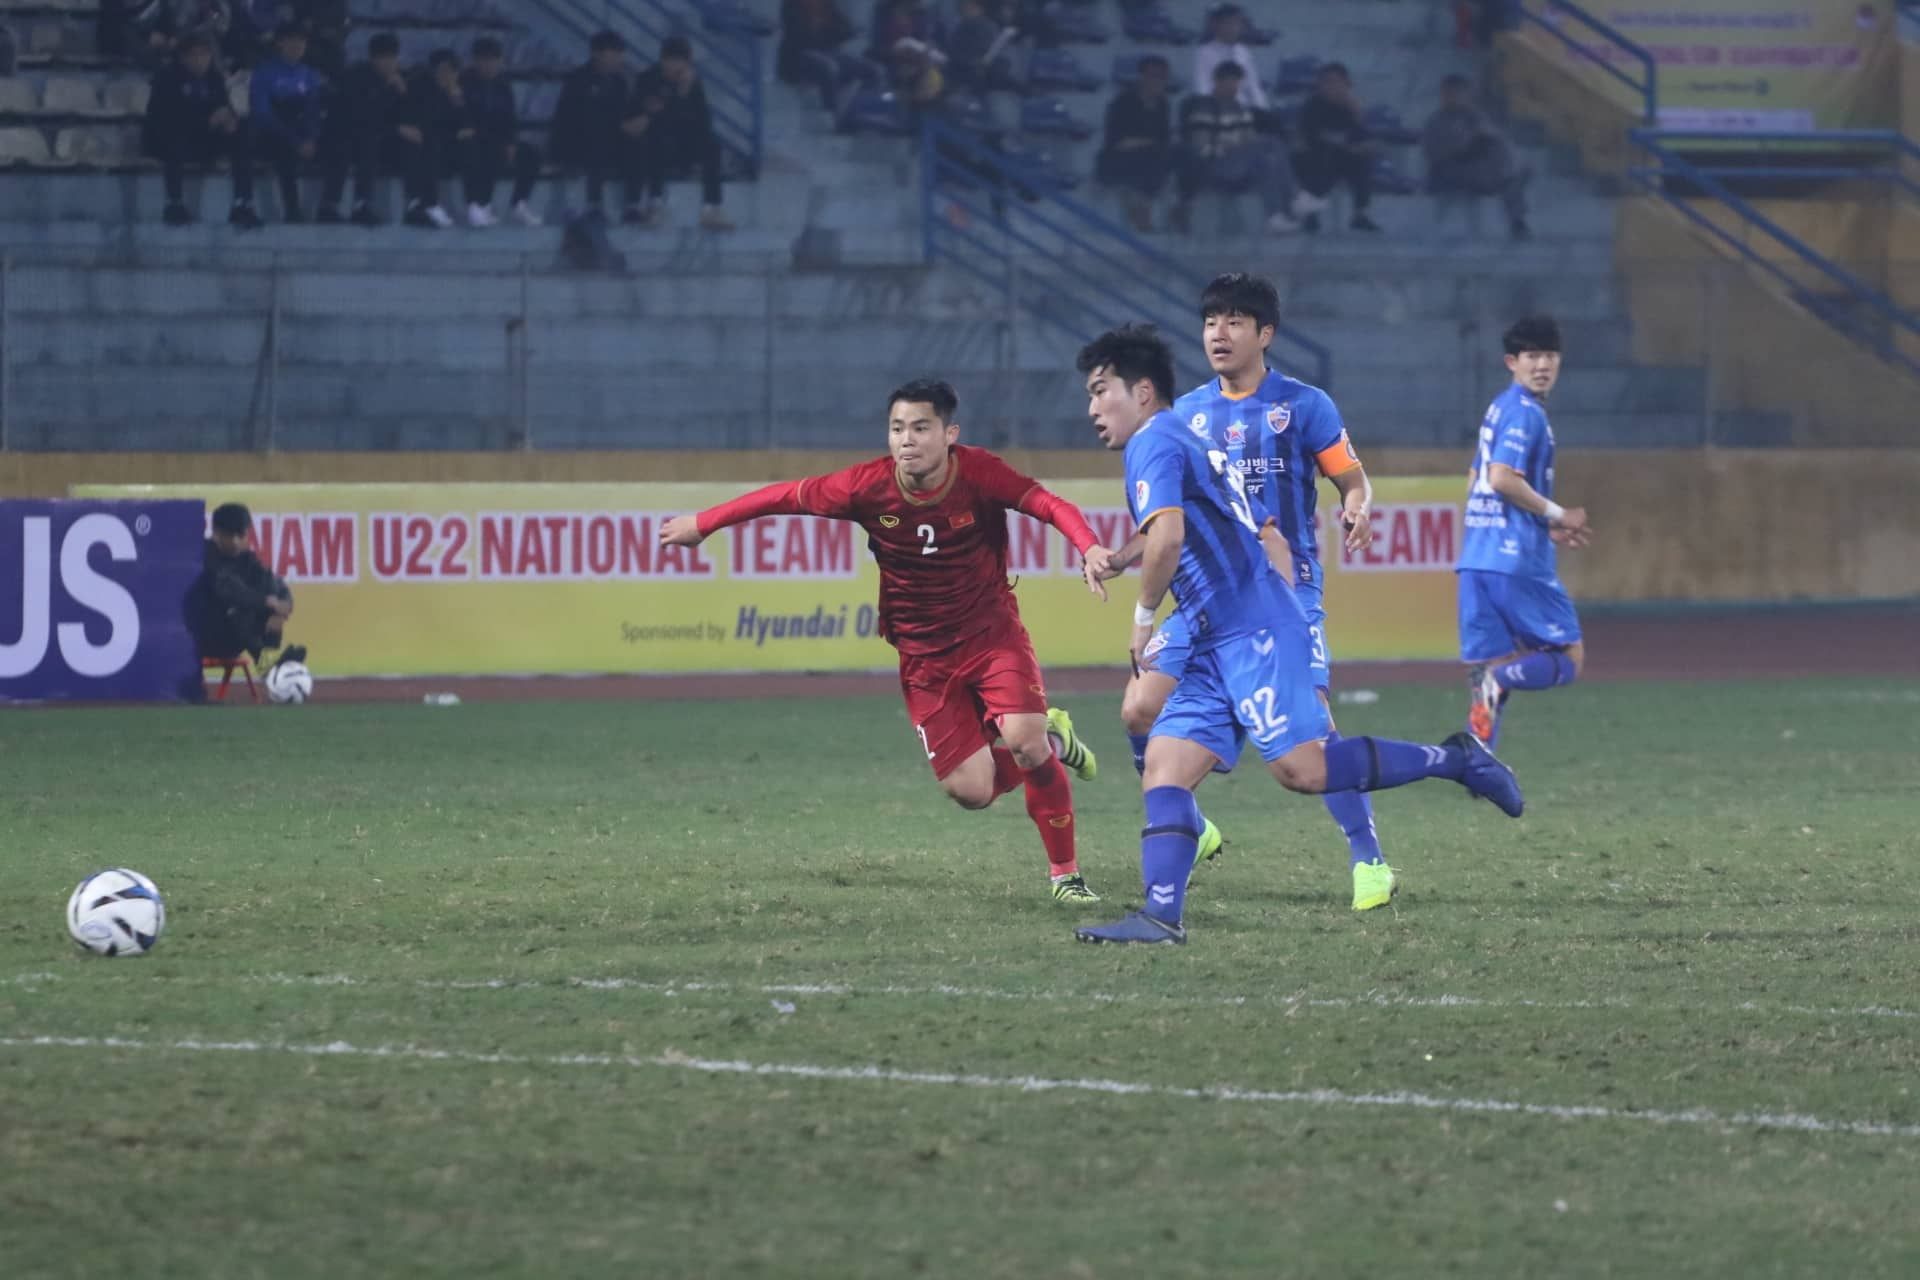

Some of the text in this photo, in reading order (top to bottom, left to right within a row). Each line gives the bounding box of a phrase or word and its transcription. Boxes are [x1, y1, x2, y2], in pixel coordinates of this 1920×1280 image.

[1235, 457, 1286, 475] 일뱅크
[247, 517, 354, 576] NAM
[373, 517, 468, 576] U22
[480, 516, 711, 574] NATIONAL
[732, 516, 854, 574] TEAM
[917, 524, 938, 555] 2
[620, 603, 879, 647] Sponsored by Hyundai O
[1240, 686, 1289, 736] 32
